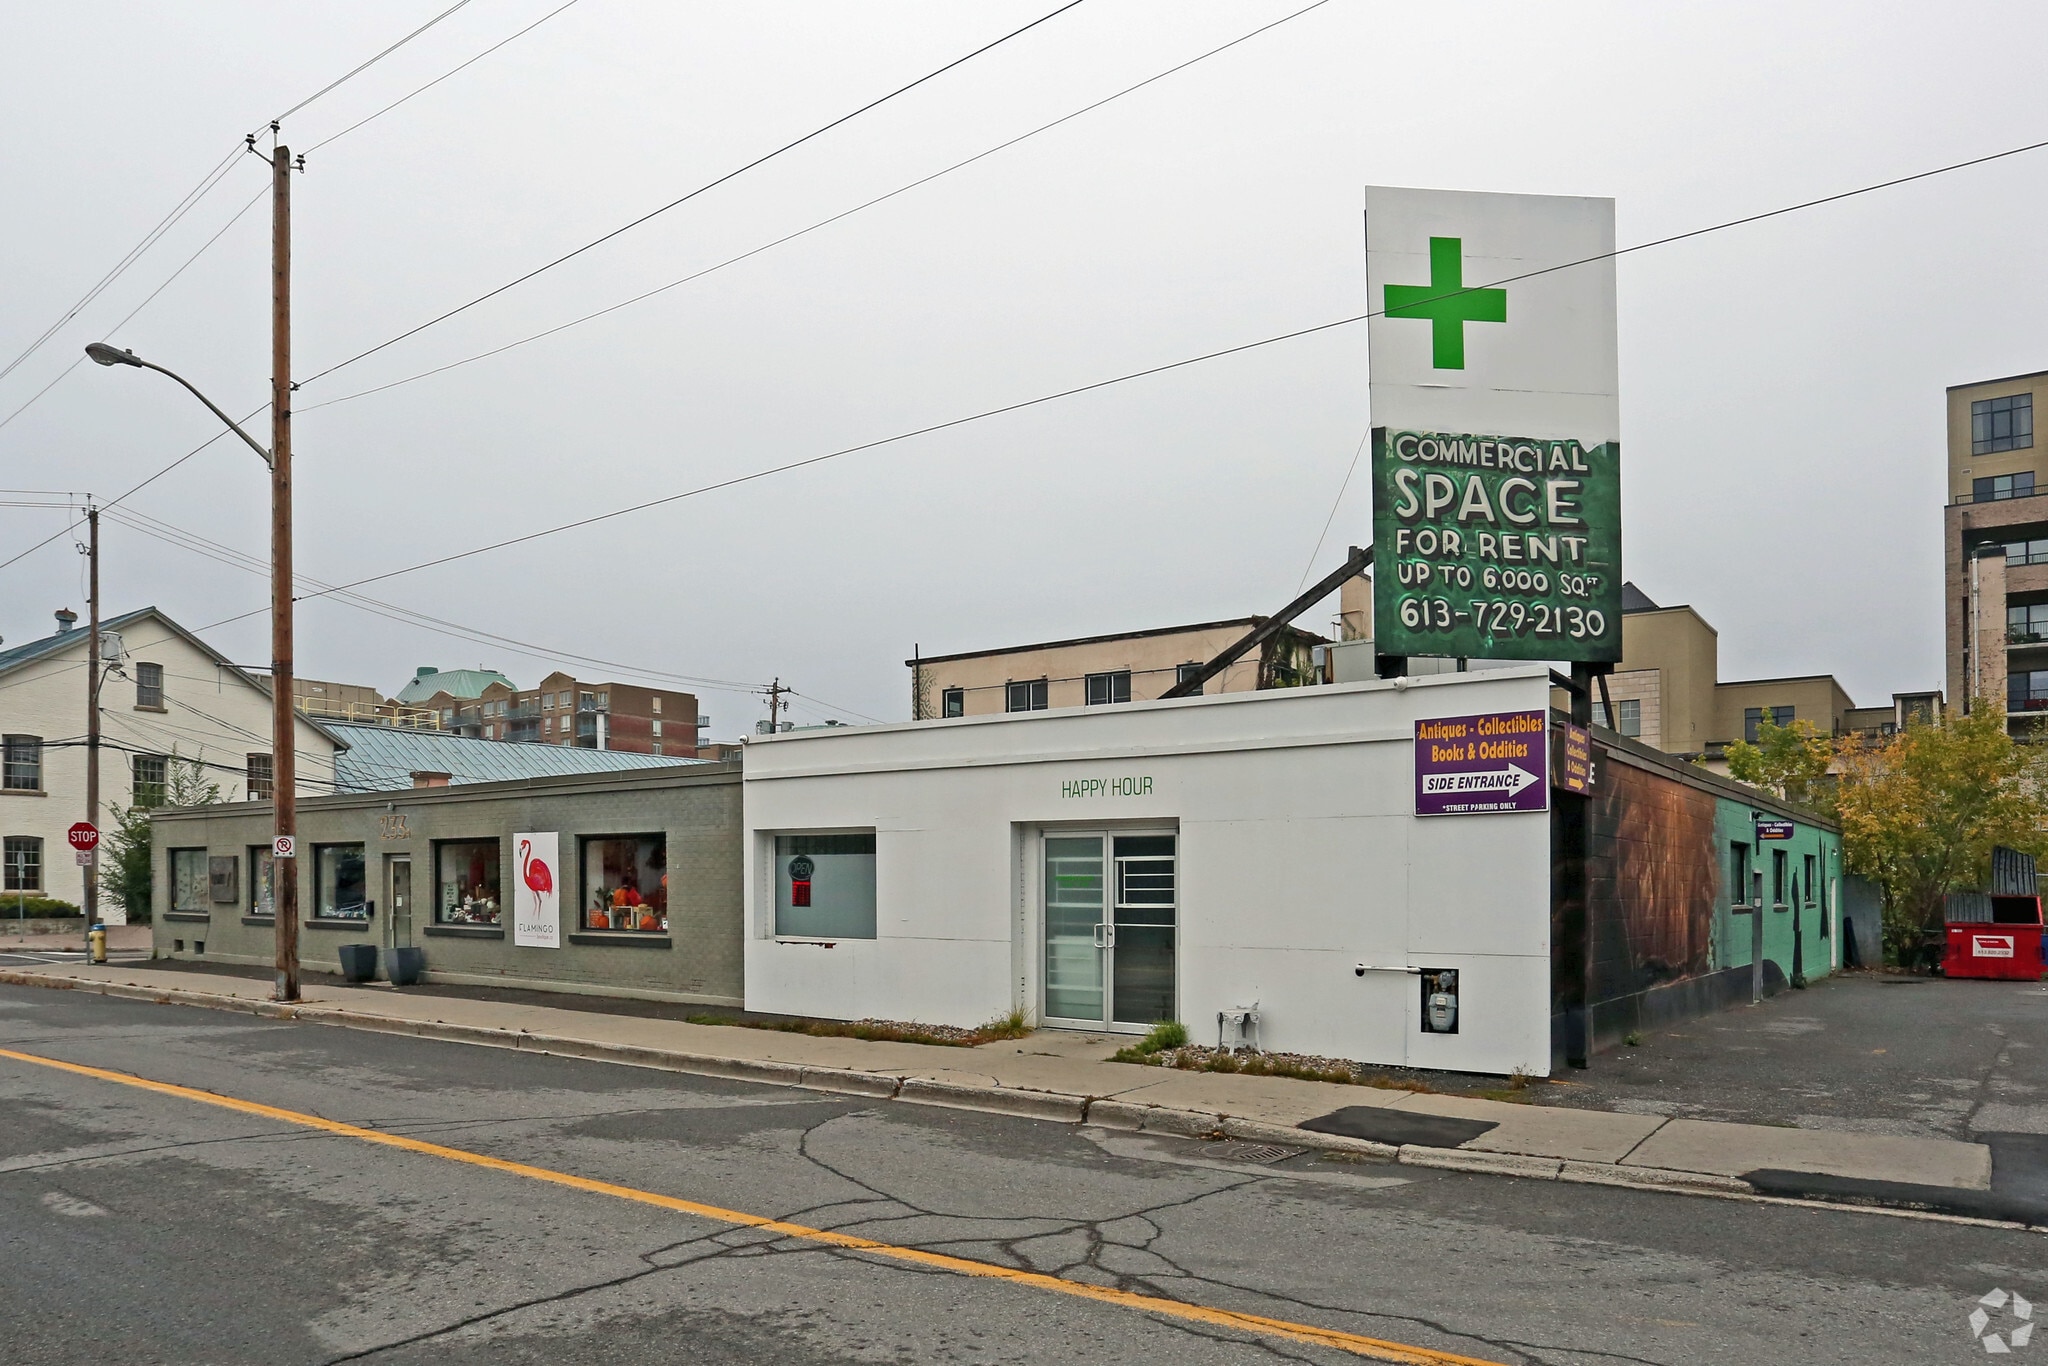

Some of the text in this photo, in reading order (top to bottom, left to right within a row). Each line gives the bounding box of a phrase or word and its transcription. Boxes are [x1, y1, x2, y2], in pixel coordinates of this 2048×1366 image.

[1396, 435, 1588, 472] COMMERCIAL
[1394, 468, 1579, 524] SPACE
[1396, 529, 1587, 562] FOR RENT
[1397, 563, 1430, 584] UP
[1438, 565, 1471, 587] TO
[1400, 598, 1605, 638] 613-729-2130
[1419, 721, 1467, 742] Antiques
[1477, 714, 1543, 736] Collectibles
[1431, 740, 1528, 763] Books & Oddities
[1062, 776, 1153, 799] HAPPY HOUR
[1427, 774, 1521, 791] SIDE ENTRANCE
[1470, 803, 1498, 811] PARKING
[1499, 802, 1517, 810] ONLY
[70, 831, 97, 842] STOP
[791, 862, 813, 875] OPEN
[519, 923, 554, 933] FLAMINGO
